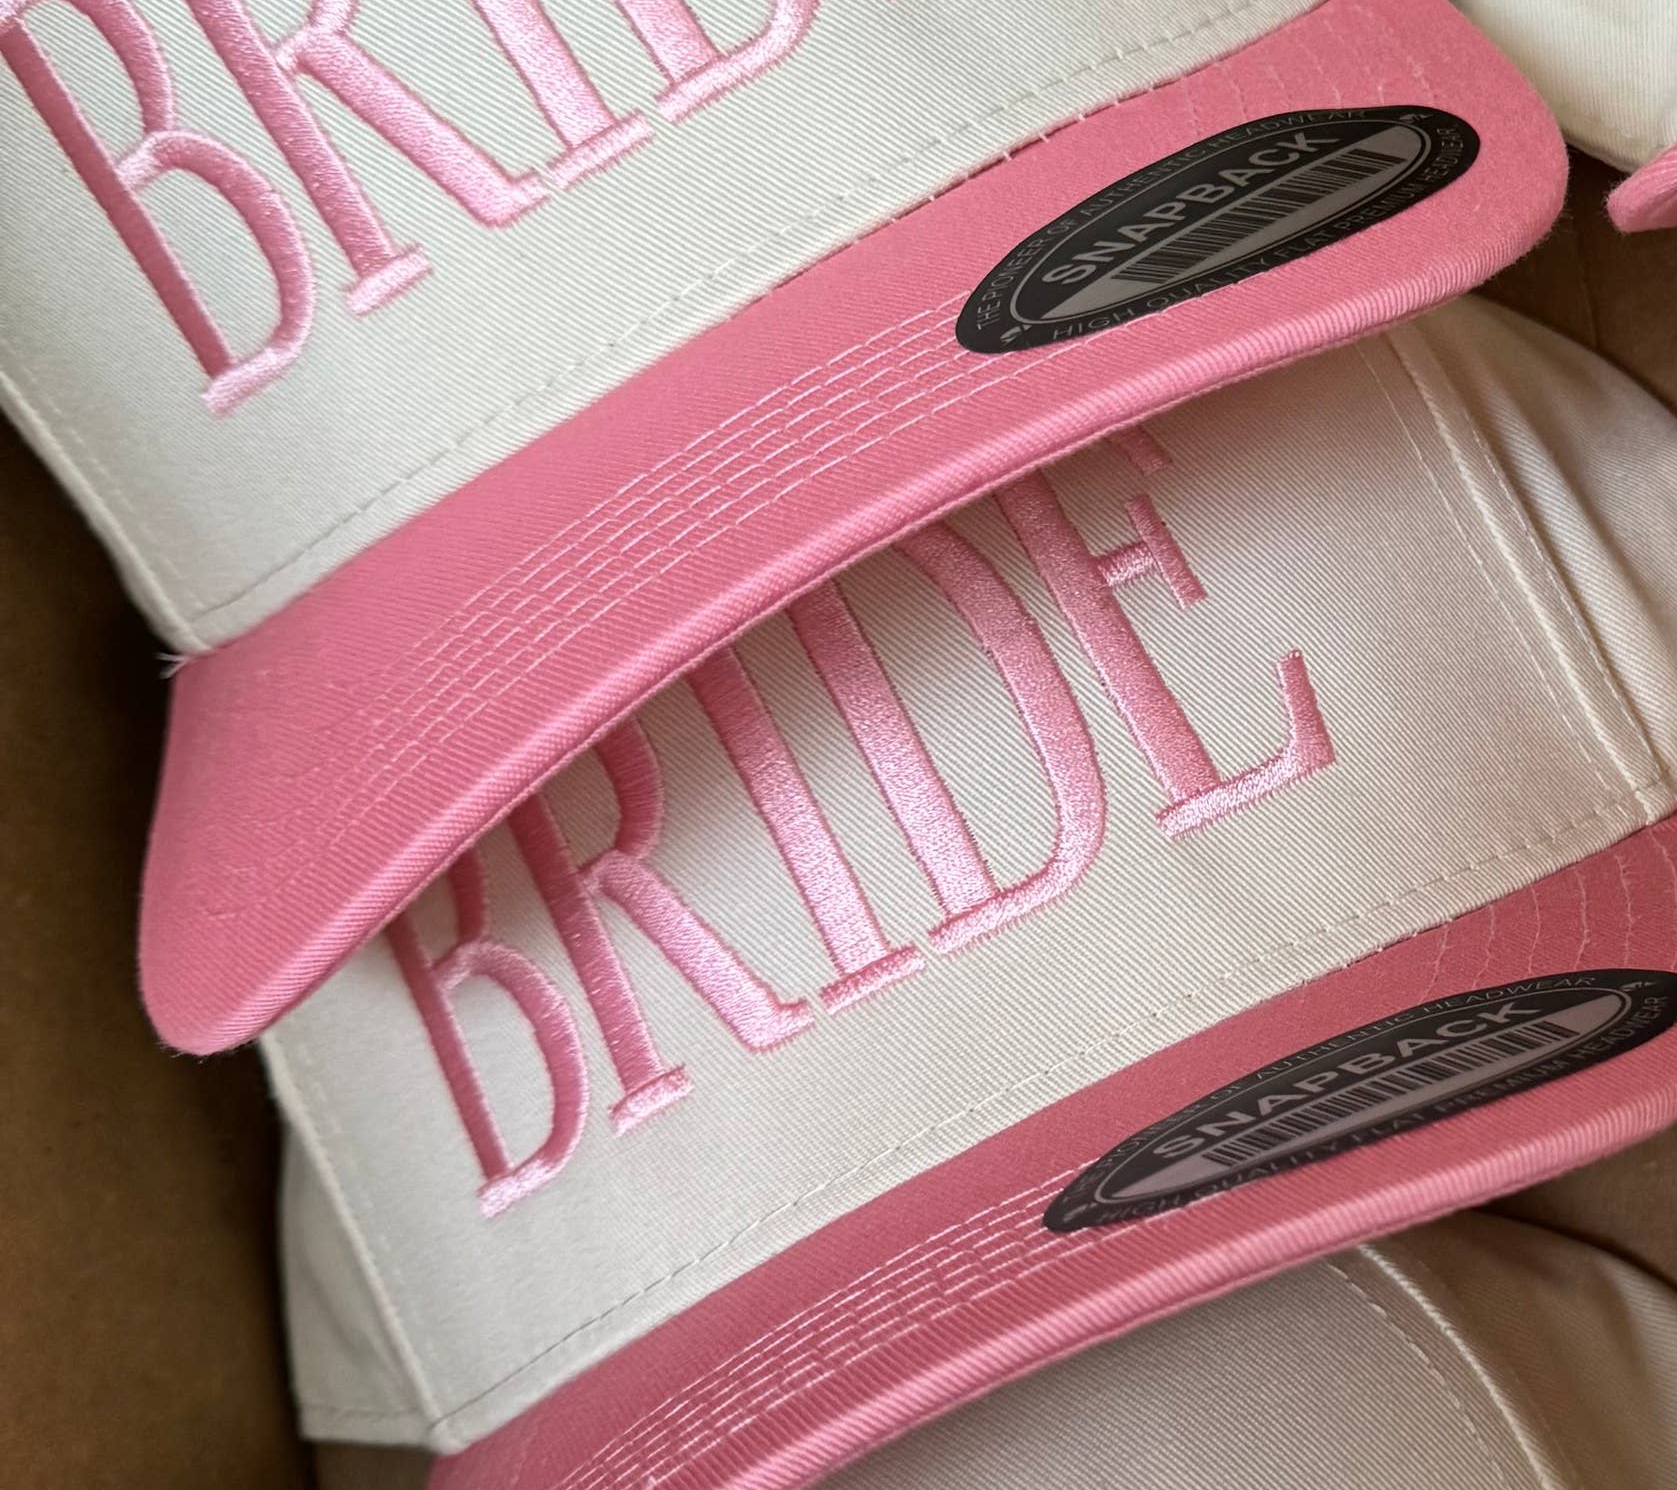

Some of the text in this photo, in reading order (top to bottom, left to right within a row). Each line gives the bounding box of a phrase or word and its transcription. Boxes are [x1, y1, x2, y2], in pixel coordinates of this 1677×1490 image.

[1041, 131, 1342, 286] SNAPBACK
[1053, 308, 1135, 341] HIGH
[1146, 257, 1271, 310] QUALITY
[1279, 227, 1335, 261] FLAT
[383, 423, 1337, 1219] BRIDE
[1152, 1000, 1542, 1159] SNAPBACK
